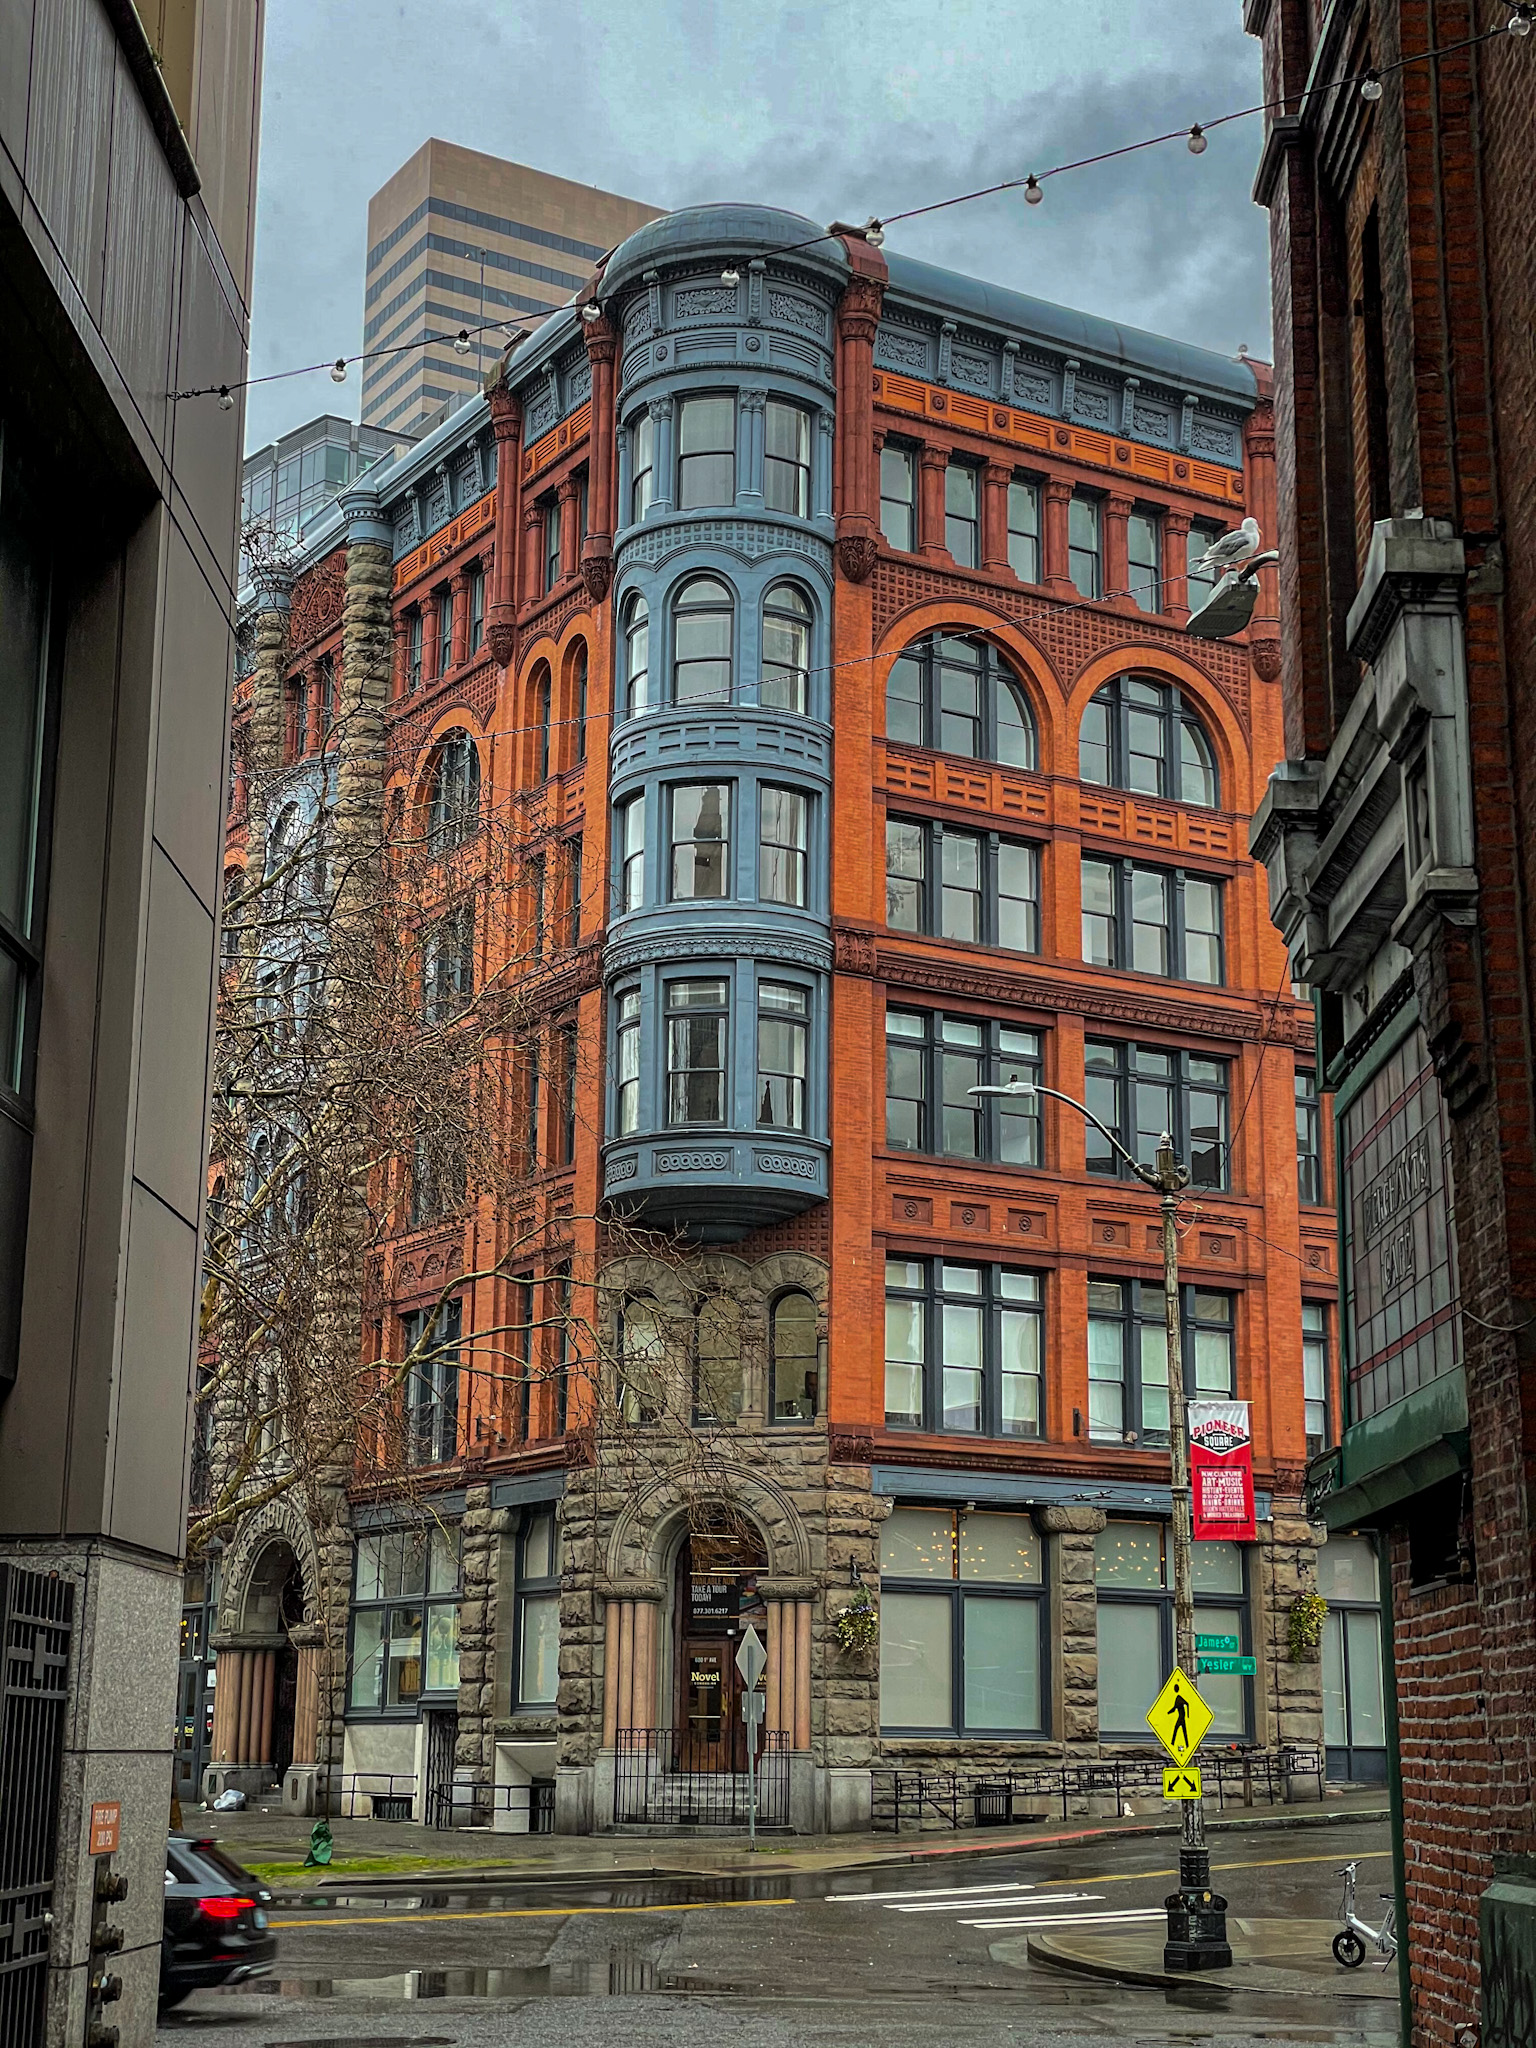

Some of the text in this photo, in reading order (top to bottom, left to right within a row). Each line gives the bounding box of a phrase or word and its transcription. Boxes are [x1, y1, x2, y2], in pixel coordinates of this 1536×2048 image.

[1193, 1419, 1246, 1440] PIONEER
[1203, 1436, 1234, 1447] SQUARE
[691, 1584, 727, 1594] TAKE A TOUR
[1199, 1636, 1225, 1648] James
[1201, 1658, 1234, 1671] Yesler
[691, 1671, 720, 1682] Novel
